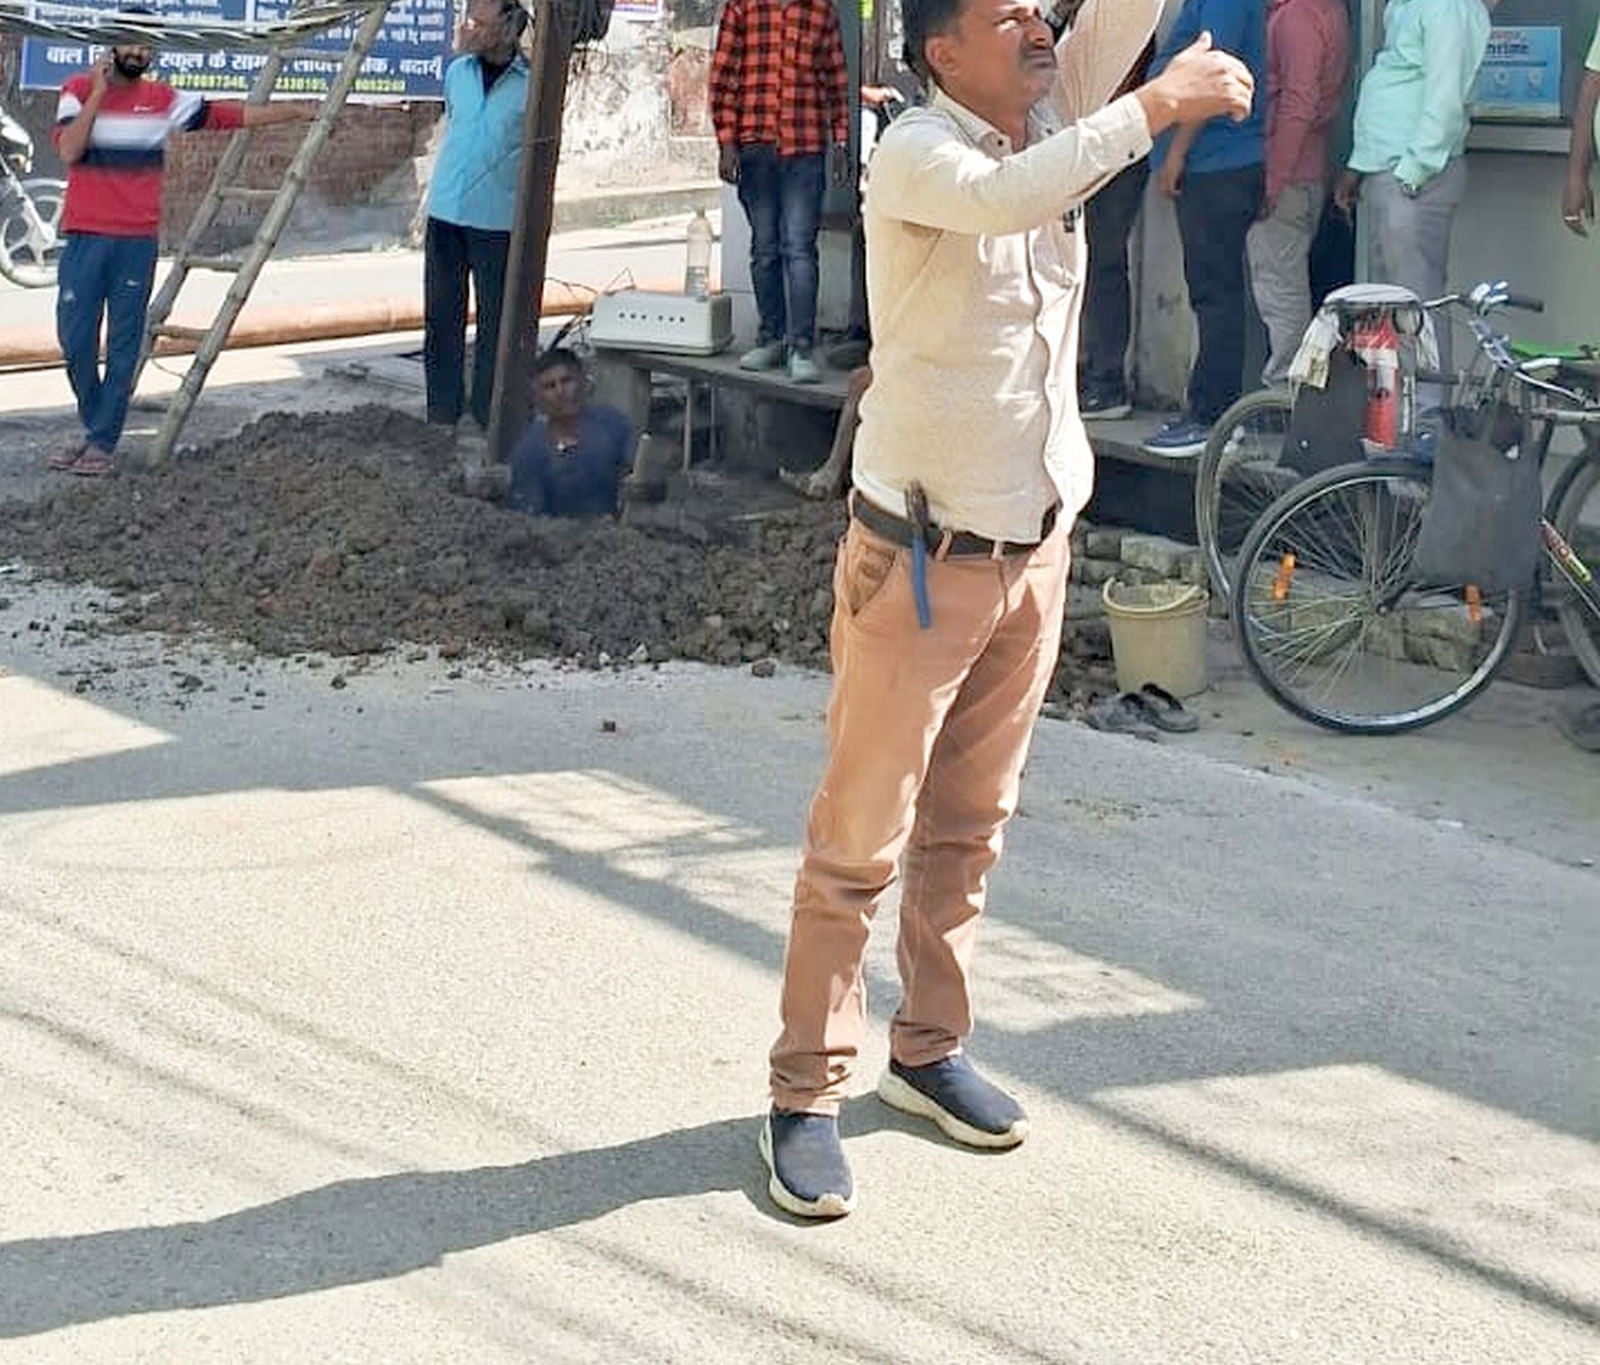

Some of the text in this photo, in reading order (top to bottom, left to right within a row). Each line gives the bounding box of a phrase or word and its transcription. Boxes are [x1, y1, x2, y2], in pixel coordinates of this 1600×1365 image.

[47, 46, 83, 64] बाल
[159, 51, 203, 73] स्कूल
[208, 50, 226, 69] के
